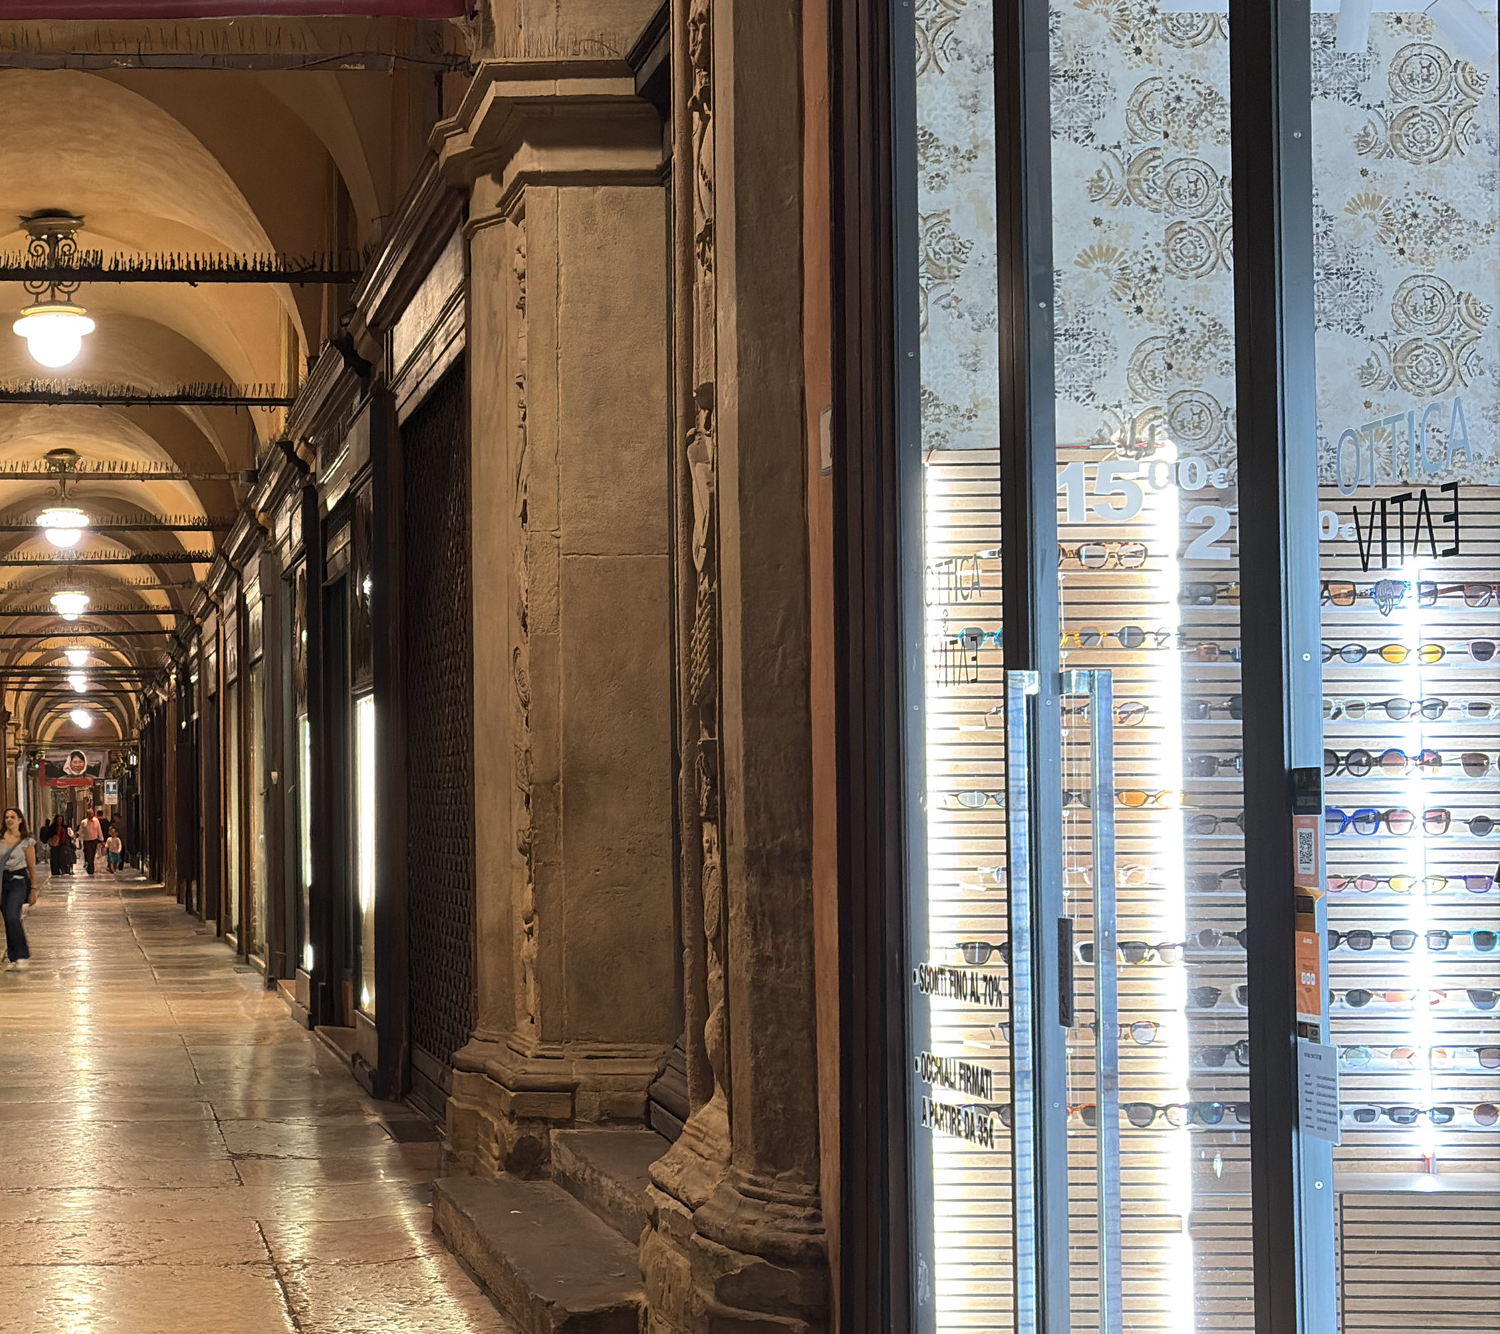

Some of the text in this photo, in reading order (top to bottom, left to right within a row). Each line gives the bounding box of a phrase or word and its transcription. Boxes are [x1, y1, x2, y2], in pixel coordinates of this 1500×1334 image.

[1336, 396, 1471, 496] OTTICA
[949, 968, 967, 1001] FINO
[970, 971, 980, 1004] AL
[983, 974, 1002, 1007] 70%
[920, 1052, 993, 1101] OCCHIALI FIRMATI
[928, 1098, 962, 1136] PARTIRE
[964, 1107, 976, 1144] DA
[978, 1113, 994, 1150] 35€
